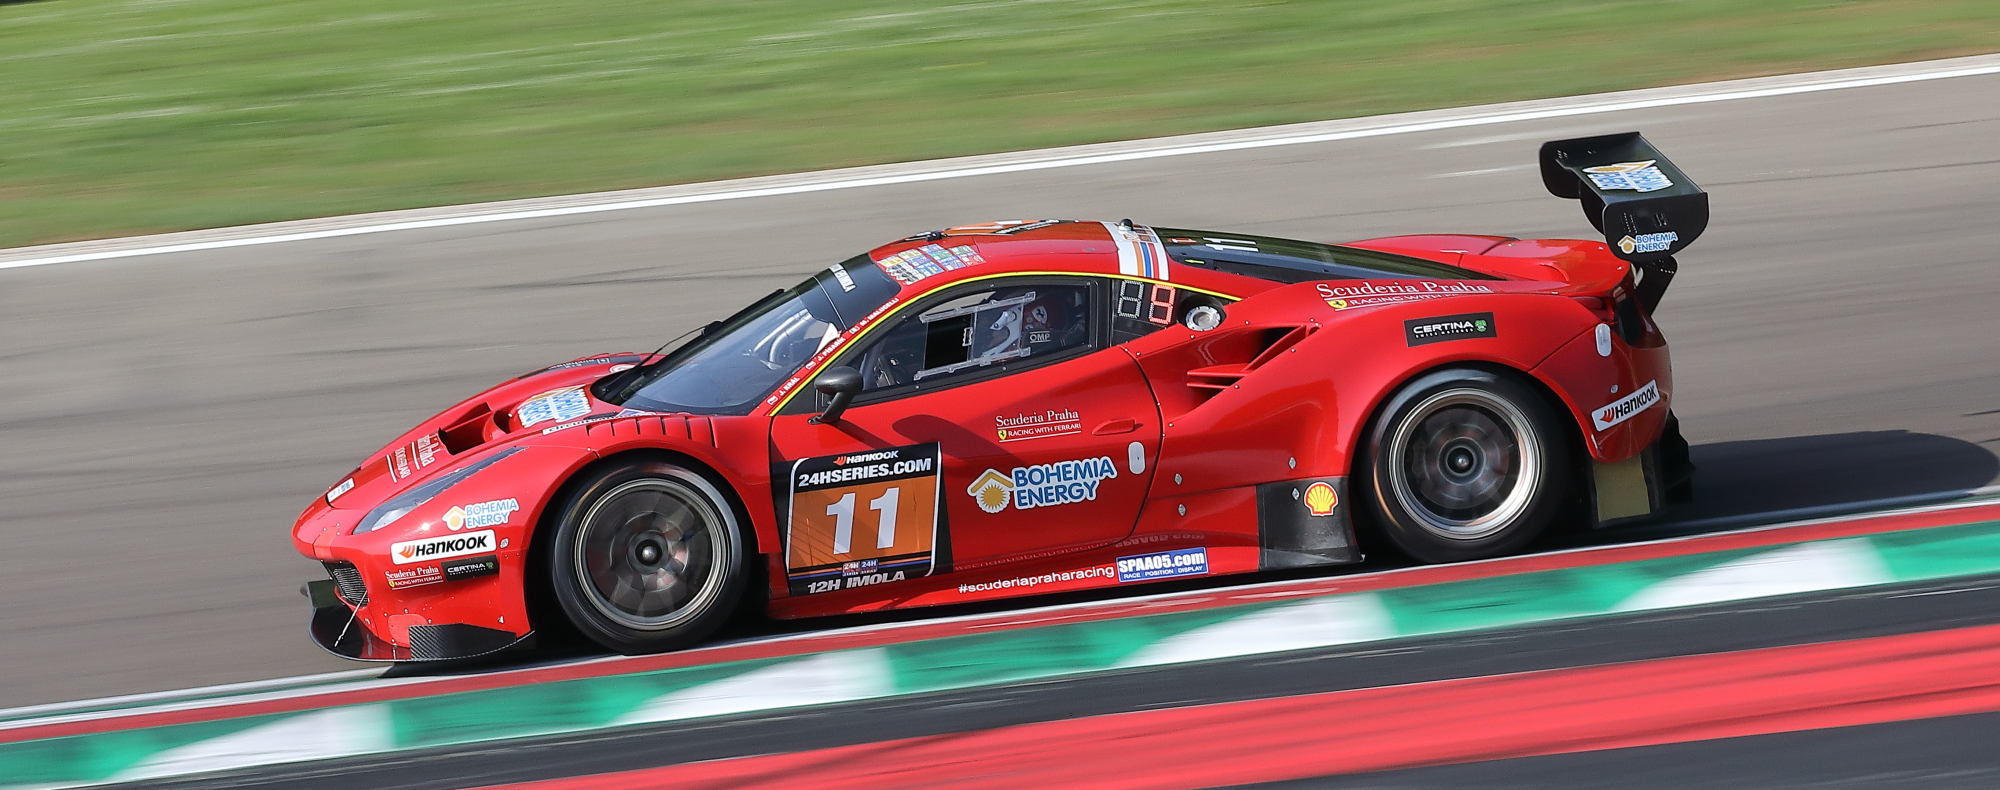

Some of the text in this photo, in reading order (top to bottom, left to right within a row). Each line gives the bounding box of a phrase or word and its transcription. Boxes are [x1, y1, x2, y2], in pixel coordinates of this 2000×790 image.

[1635, 232, 1678, 244] BOHEMIA
[1637, 241, 1670, 252] ENERGY
[1316, 281, 1491, 298] Scuderia Praha
[1350, 294, 1404, 306] RACING
[1413, 320, 1474, 334] CERTINA
[1030, 332, 1050, 342] OMP
[996, 408, 1079, 427] Scuderia Praha
[1008, 423, 1082, 437] RACING WITH FERRARI
[798, 457, 931, 487] 24HSERIES.COM
[1014, 459, 1115, 488] BOHEMIA
[1016, 480, 1097, 507] ENERGY
[466, 499, 518, 516] BOHEMIA
[467, 511, 508, 527] ENERGY
[826, 487, 900, 555] 11
[447, 563, 485, 573] CERTINA
[861, 560, 877, 568] 24H
[1118, 552, 1205, 573] SPAA05.com
[385, 568, 416, 579] Scuderia
[416, 565, 439, 576] Praha
[958, 565, 1114, 594] #scuderiapraharacing
[1145, 569, 1174, 577] POSITION
[808, 570, 905, 594] 12H IMOLA
